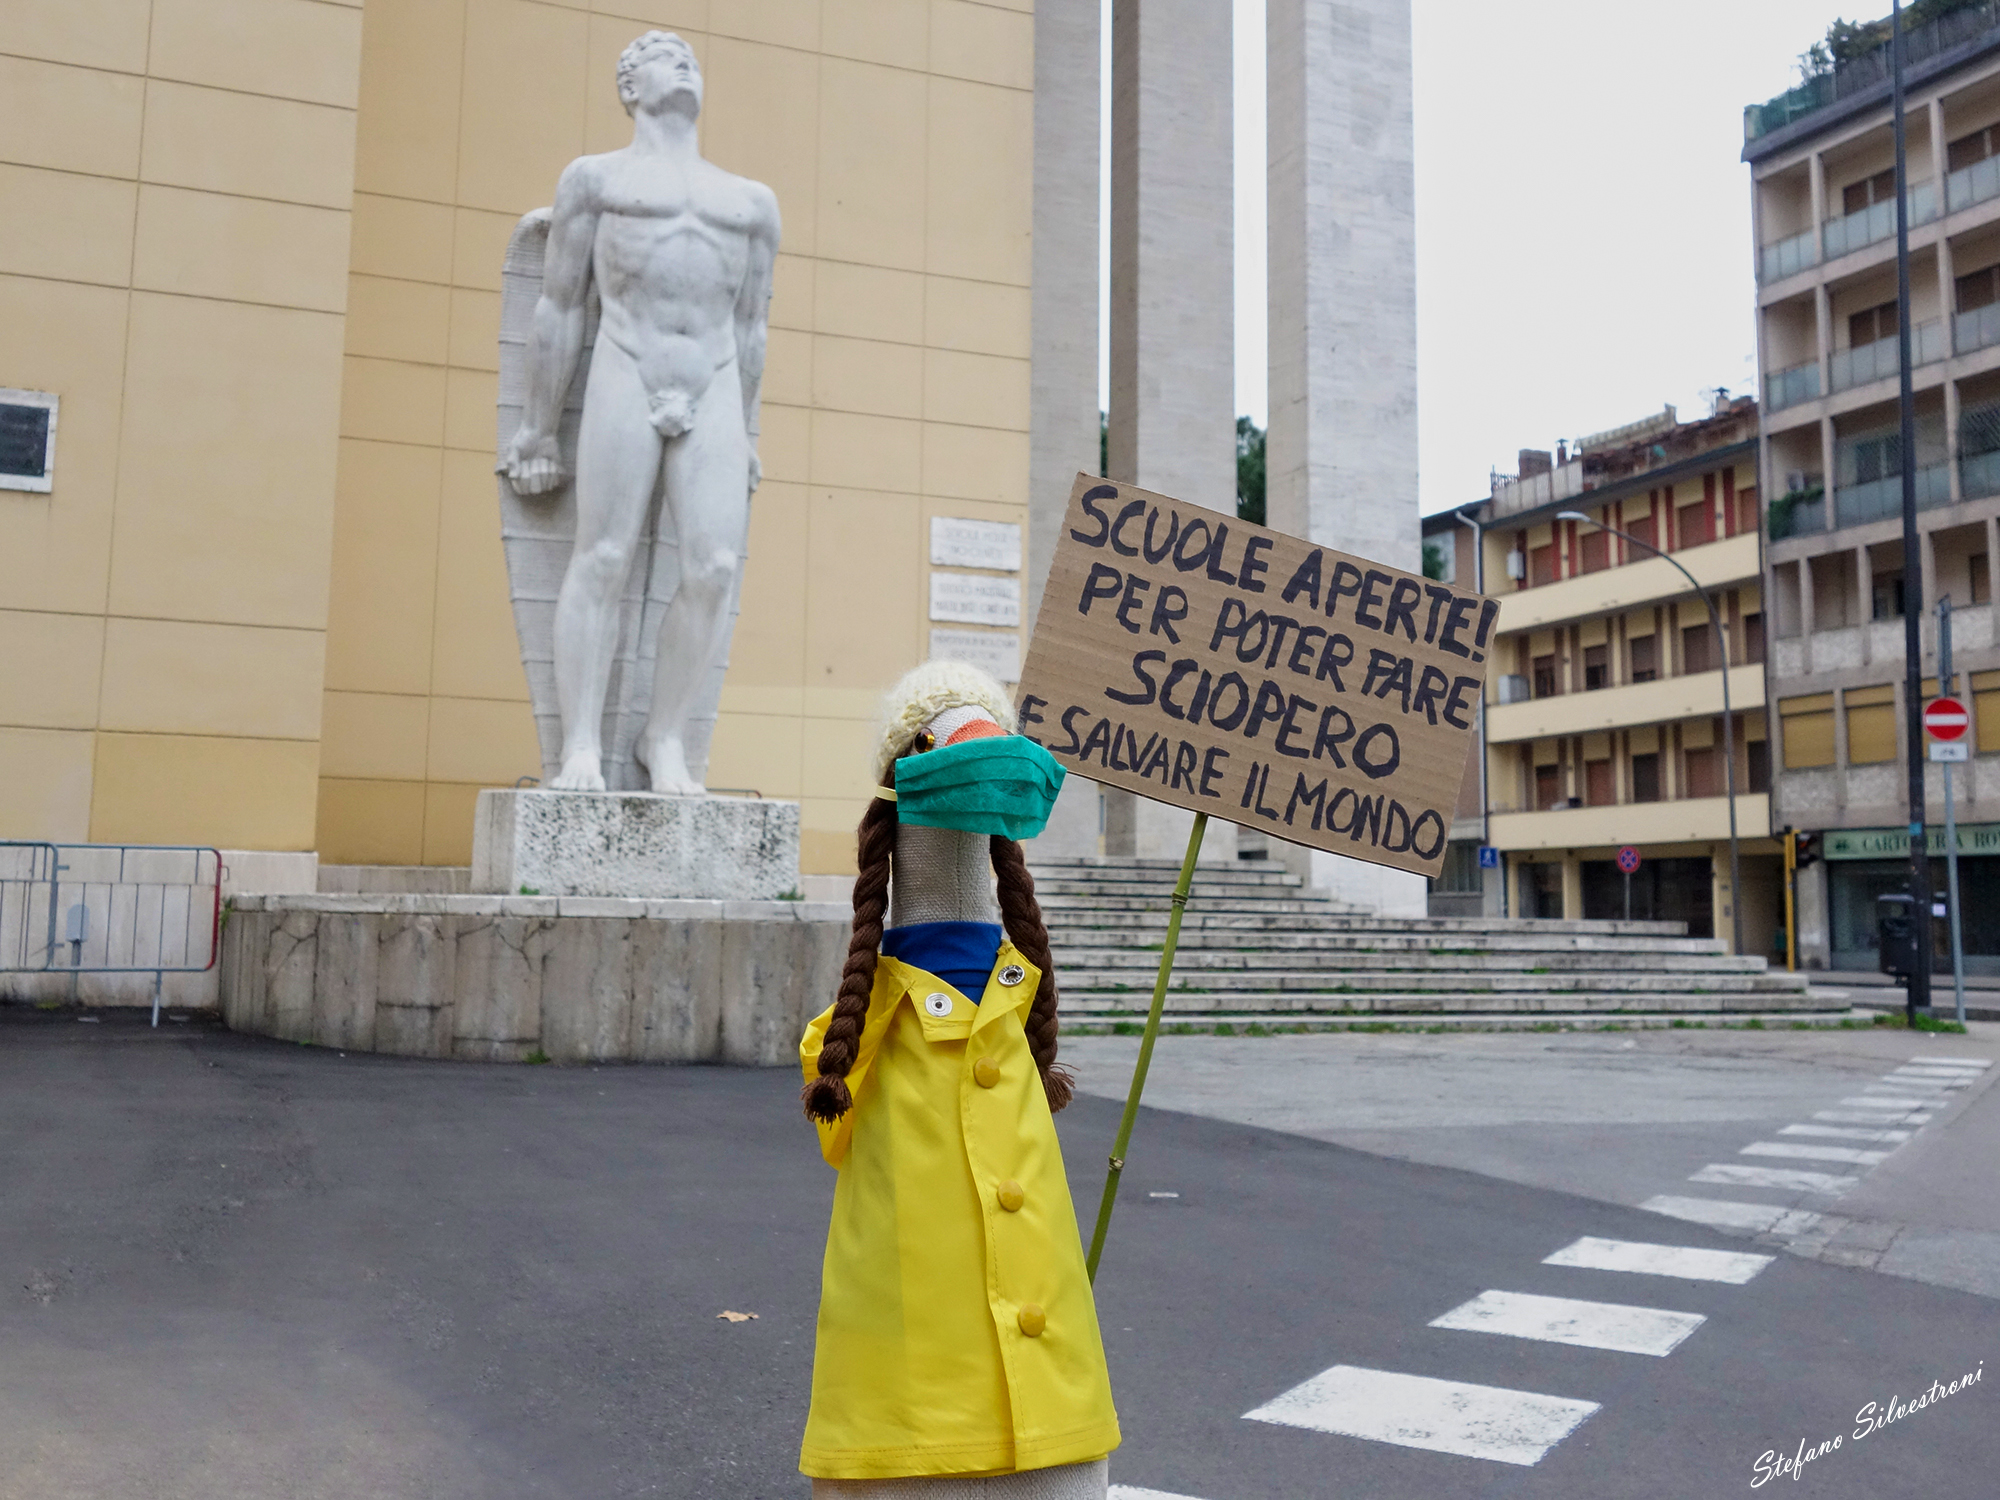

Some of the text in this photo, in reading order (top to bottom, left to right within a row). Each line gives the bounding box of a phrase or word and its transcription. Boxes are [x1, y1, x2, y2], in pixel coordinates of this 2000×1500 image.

[1069, 484, 1499, 663] SCUOLE APERTE!
[1078, 561, 1482, 730] PER POTER FARE
[1018, 693, 1446, 861] E SALVARE IL MONDO
[1103, 649, 1401, 780] SCIOPERO
[1862, 832, 1963, 852] CARTORA
